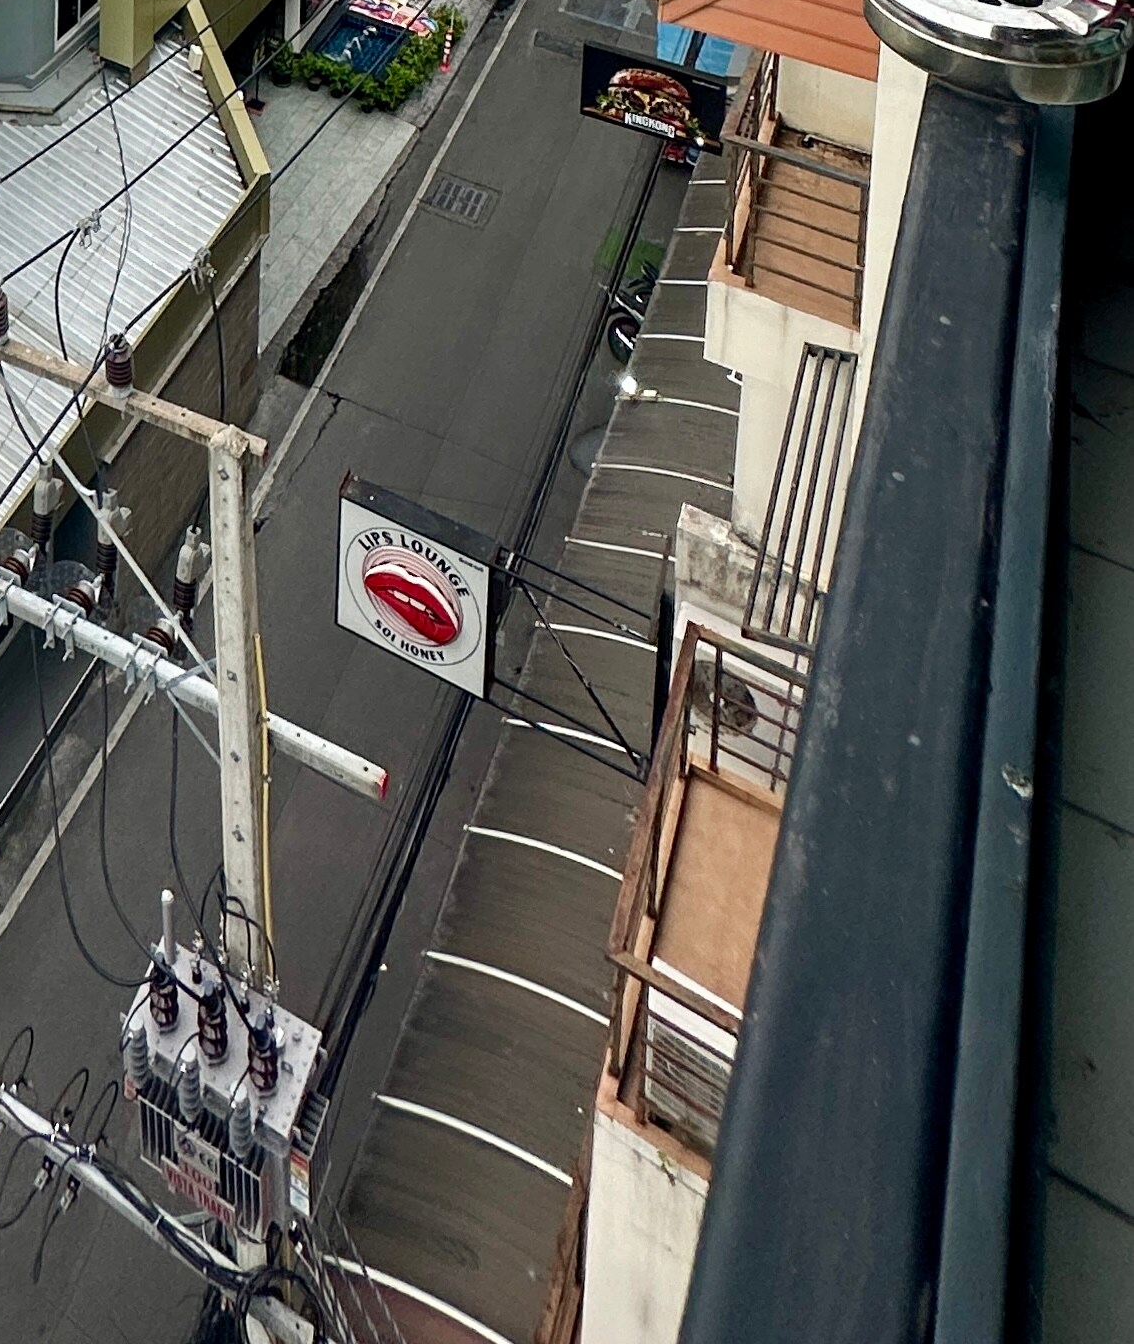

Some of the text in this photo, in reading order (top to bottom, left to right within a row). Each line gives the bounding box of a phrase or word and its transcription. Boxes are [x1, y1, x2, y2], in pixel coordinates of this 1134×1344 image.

[624, 112, 676, 139] KINGKONG
[358, 531, 470, 598] LIPS LOUNGE
[374, 619, 445, 662] SOI HONEY
